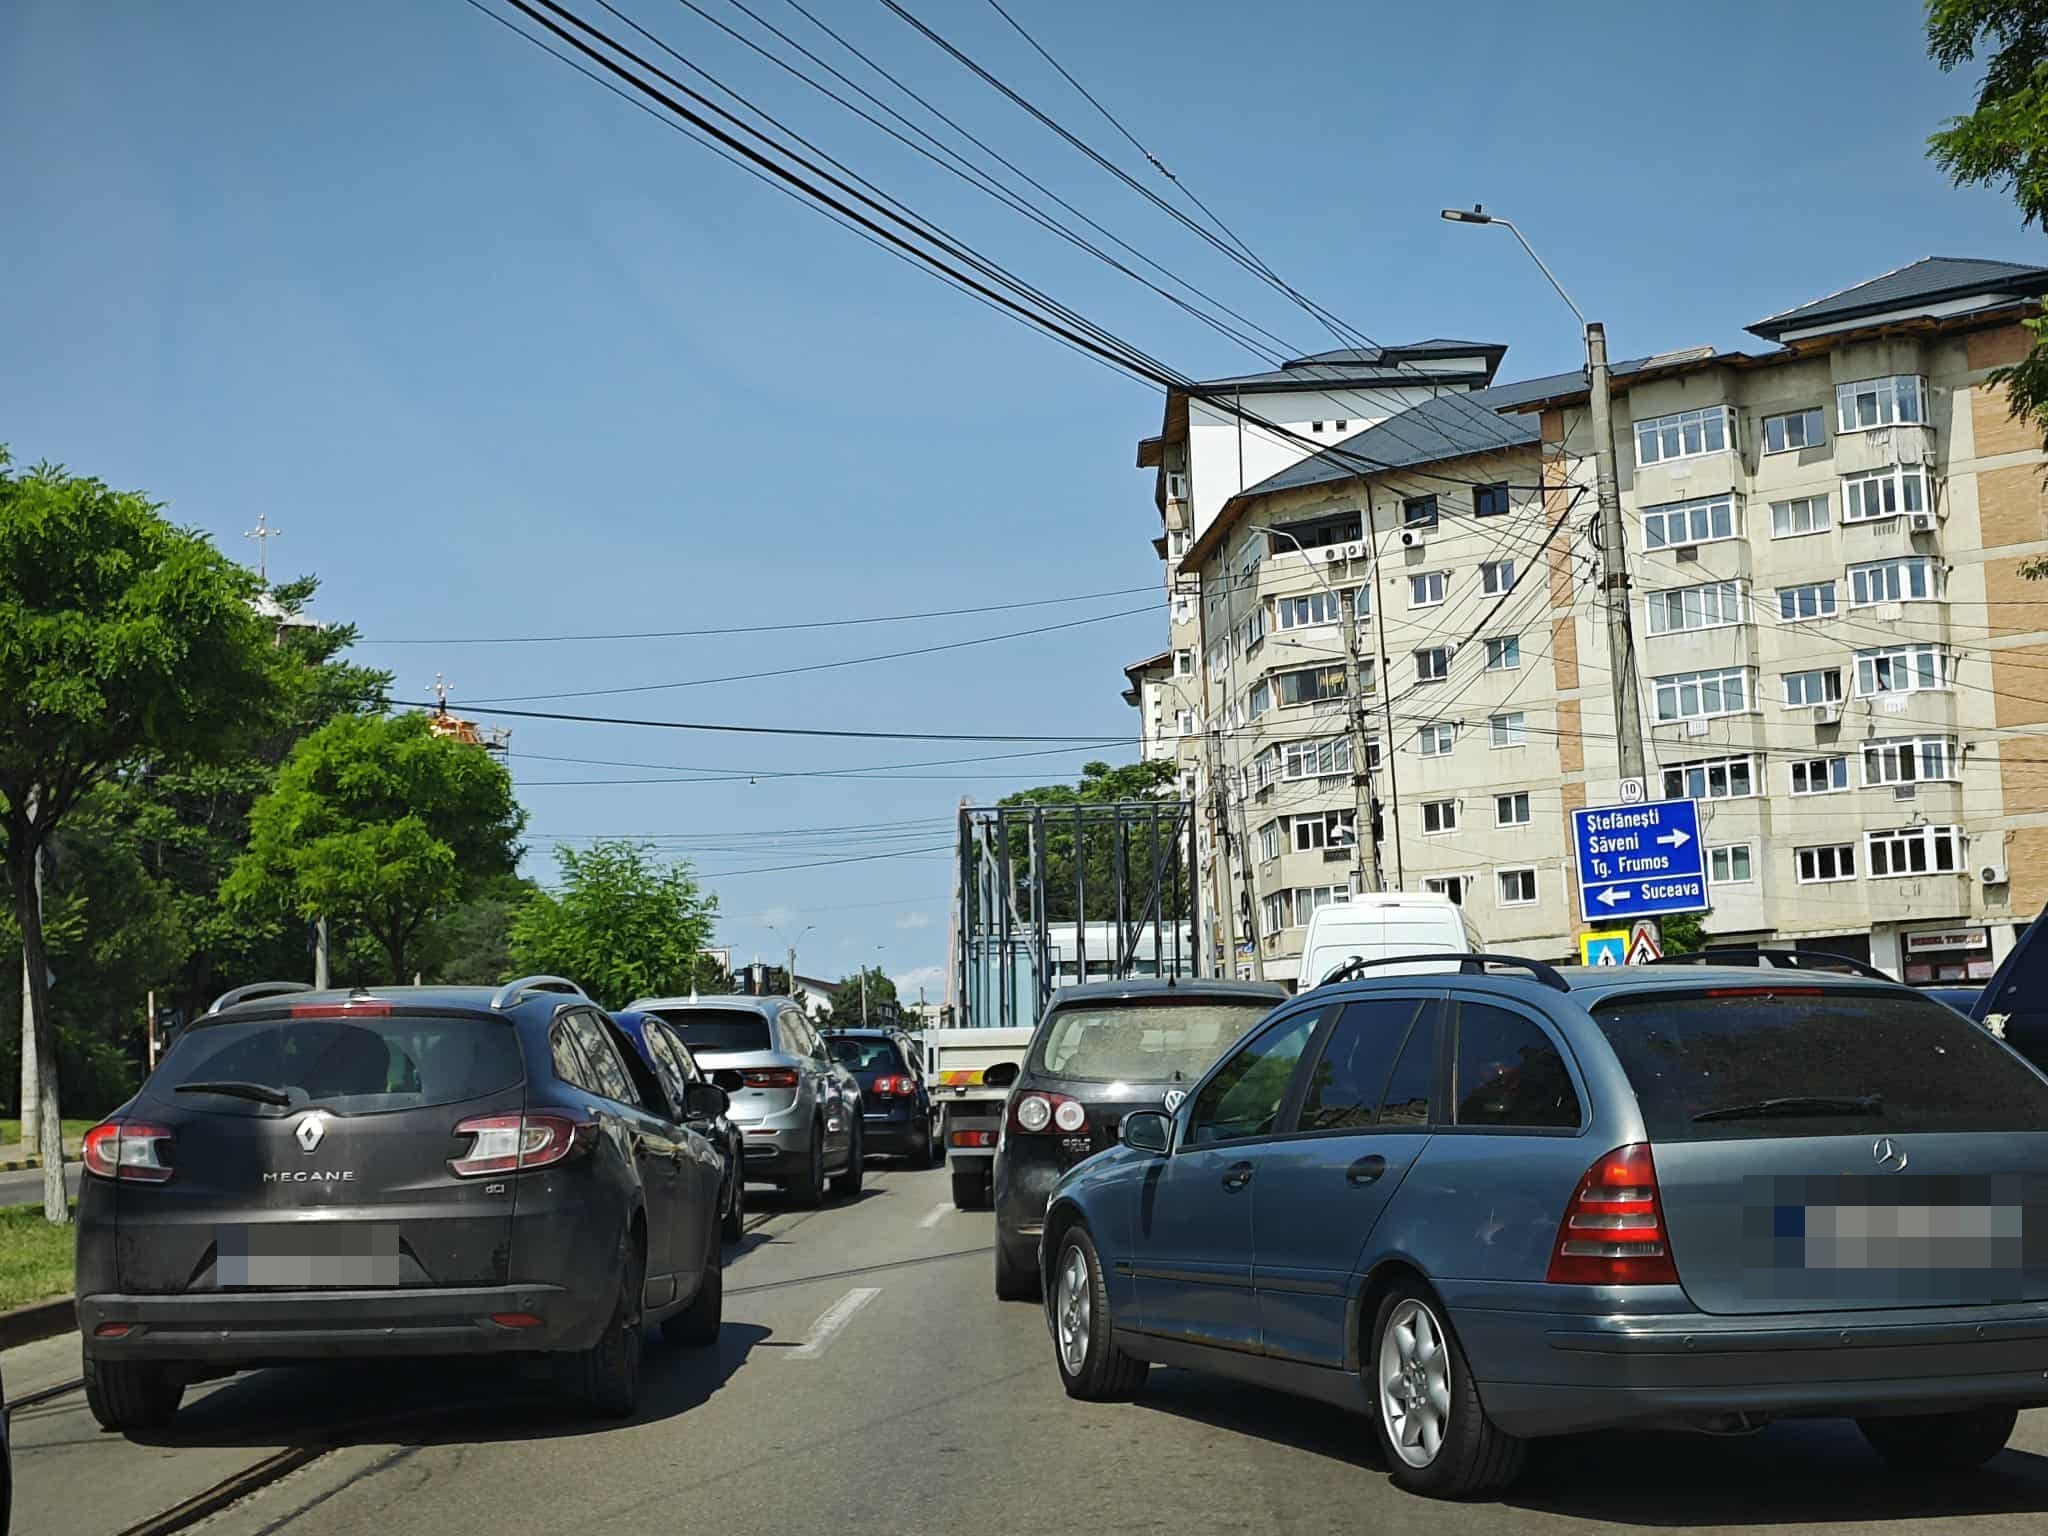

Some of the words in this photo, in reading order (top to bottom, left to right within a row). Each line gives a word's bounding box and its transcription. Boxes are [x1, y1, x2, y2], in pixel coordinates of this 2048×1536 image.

[1625, 784, 1636, 795] 10
[1587, 808, 1660, 833] Ștefănești
[1589, 832, 1639, 854] Săveni
[1591, 859, 1612, 879] Tg.
[1618, 855, 1669, 873] Frumos
[1641, 882, 1699, 900] Suceava
[263, 1170, 356, 1182] MEGANE
